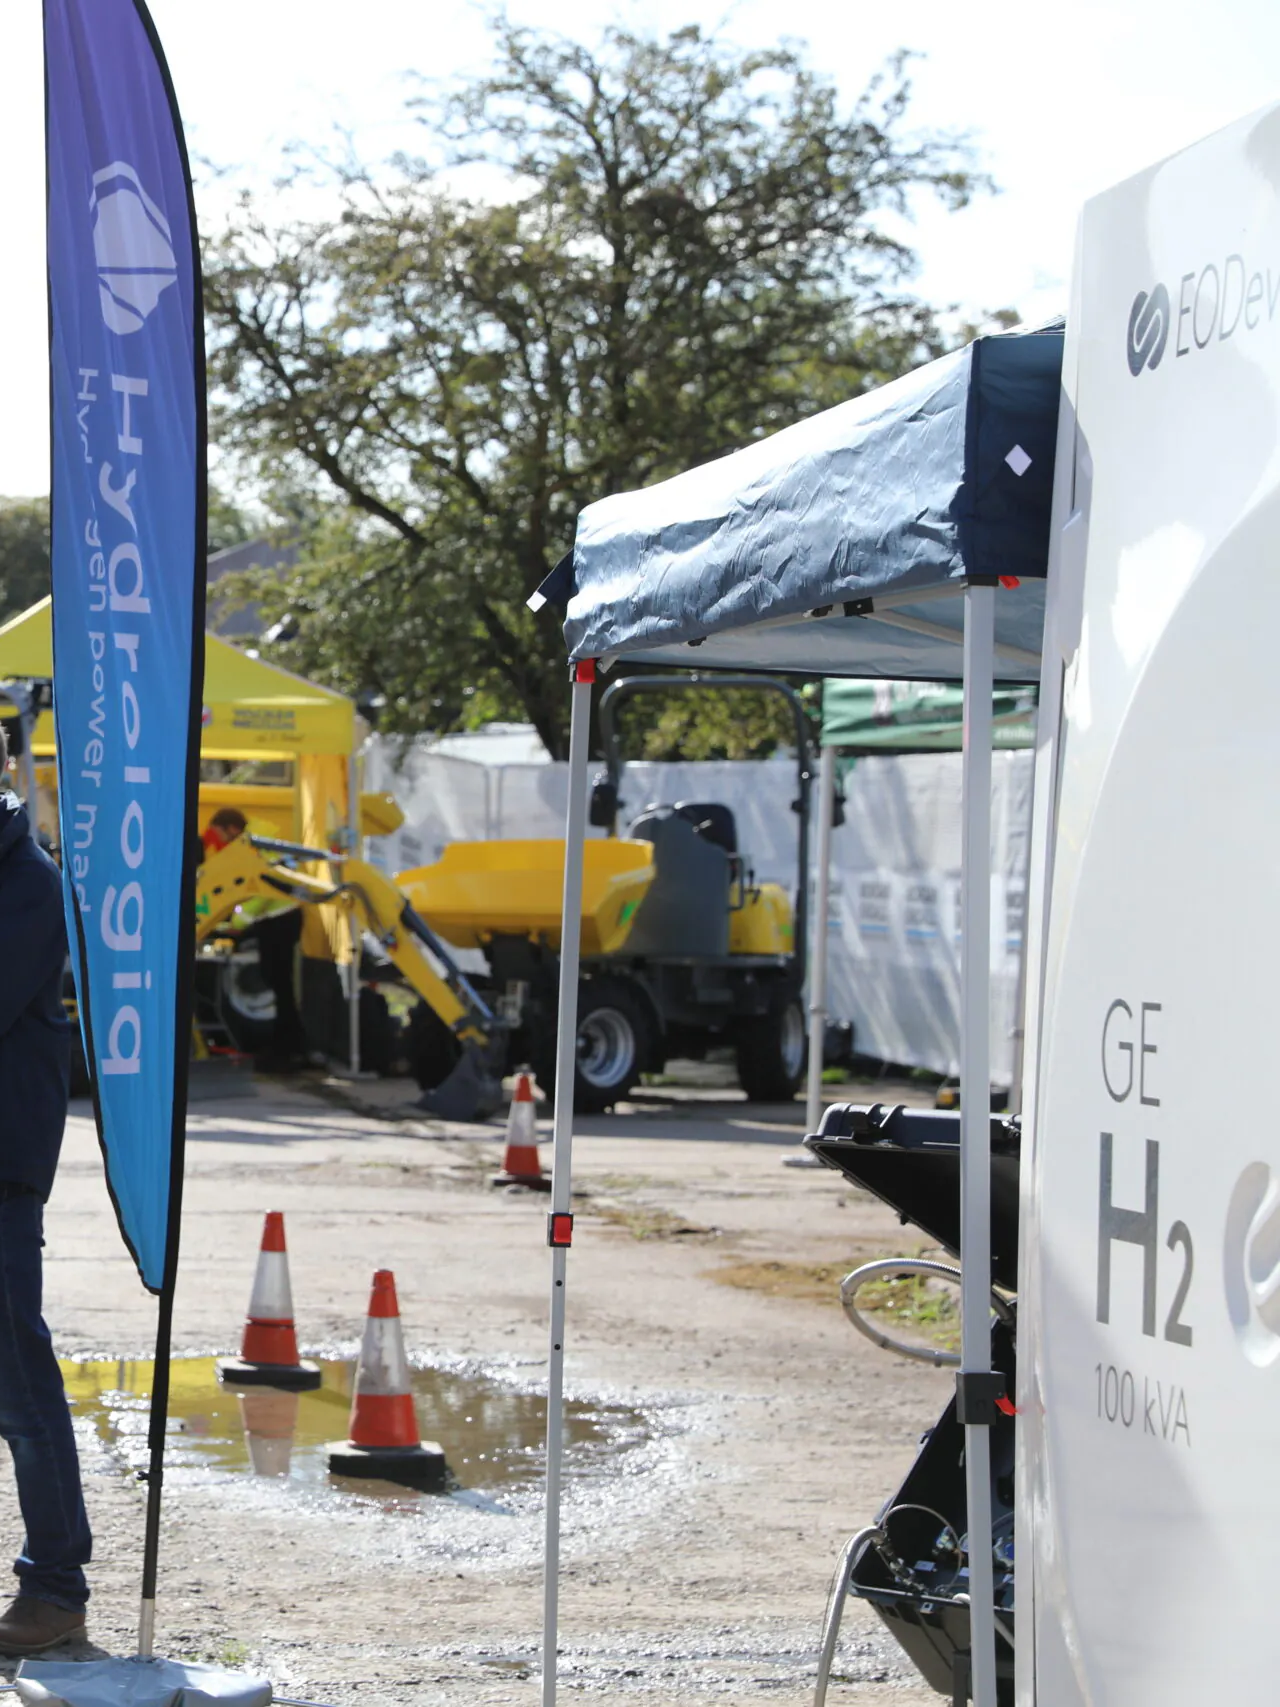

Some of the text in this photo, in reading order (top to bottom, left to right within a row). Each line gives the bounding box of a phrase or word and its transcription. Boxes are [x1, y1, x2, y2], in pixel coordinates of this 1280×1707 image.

[1176, 253, 1280, 358] EODev
[81, 631, 106, 788] power
[99, 373, 152, 1075] Hydrologiq
[1101, 998, 1163, 1107] GE
[1096, 1131, 1193, 1348] H2
[1094, 1362, 1192, 1448] 100 kVA
